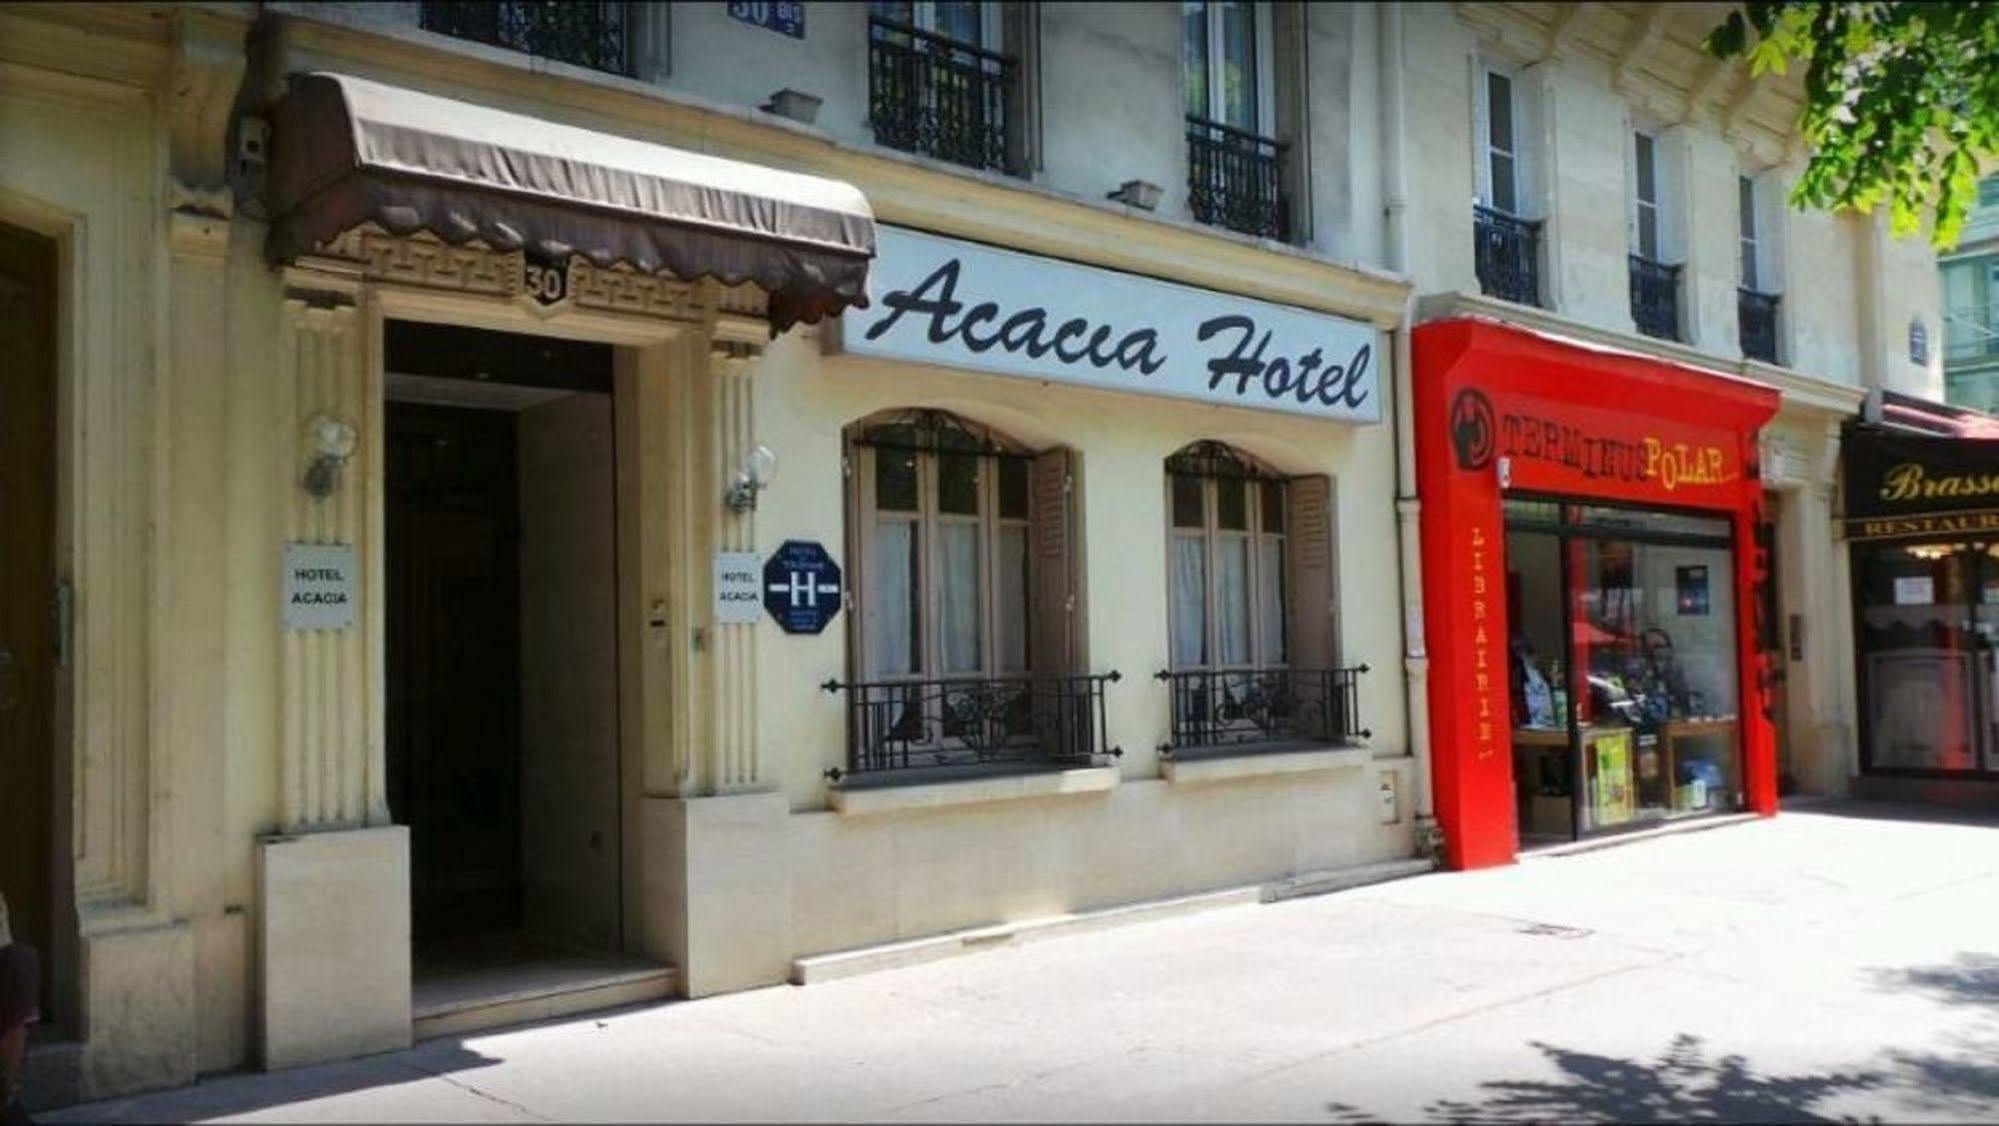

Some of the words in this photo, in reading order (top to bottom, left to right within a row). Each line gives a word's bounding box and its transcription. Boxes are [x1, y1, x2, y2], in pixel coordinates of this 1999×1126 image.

[526, 265, 561, 299] 30
[865, 259, 1166, 375] Acacia
[1197, 314, 1371, 408] Hotel
[1643, 437, 1724, 490] POLAR
[294, 568, 343, 581] HOTEL
[721, 572, 757, 583] HOTEL
[291, 592, 347, 605] ACACIA
[720, 592, 759, 602] ACACIA
